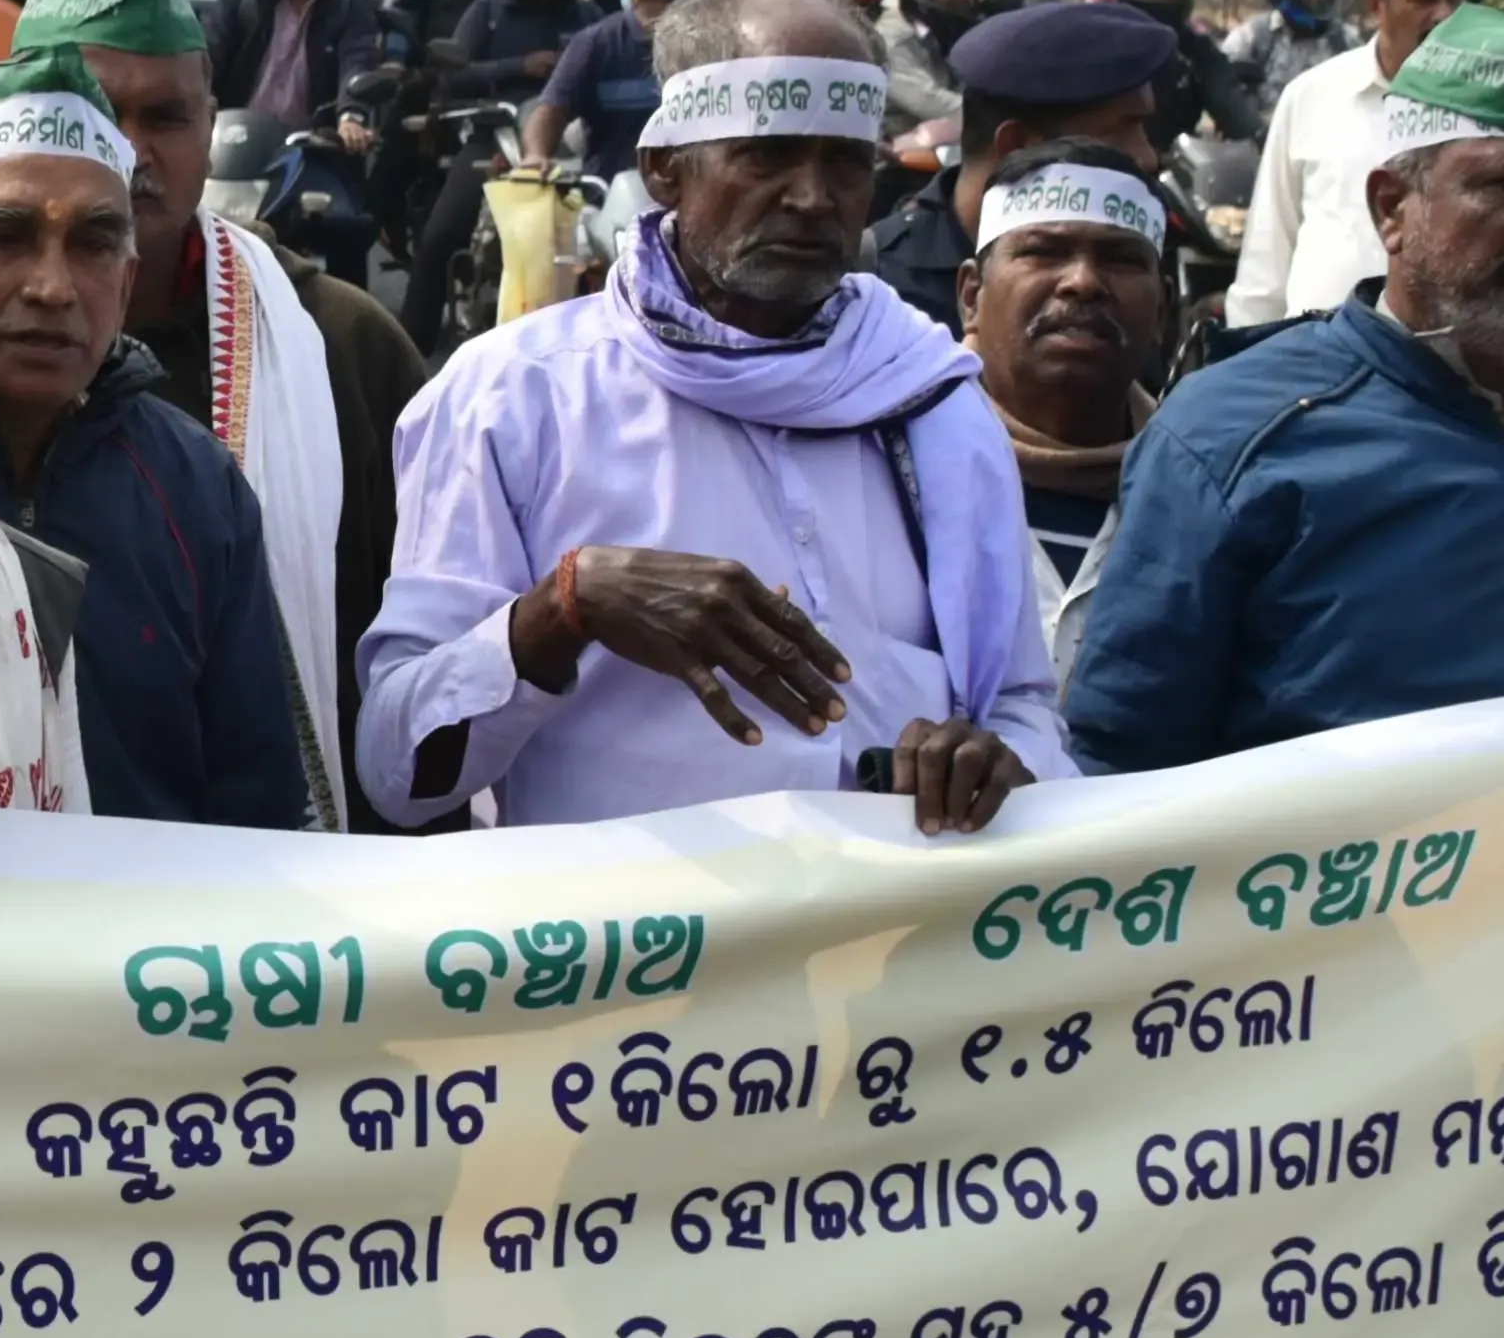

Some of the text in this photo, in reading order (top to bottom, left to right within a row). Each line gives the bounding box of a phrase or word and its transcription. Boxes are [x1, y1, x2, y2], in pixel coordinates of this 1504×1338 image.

[744, 78, 812, 126] କୃଷକ
[972, 865, 1196, 961] ଦେଶ
[24, 1065, 298, 1204] କହୁଛନ୍ତି
[338, 1065, 498, 1153] କାଟ
[855, 1036, 915, 1126] ରୁ
[1131, 976, 1315, 1060] କିଲୋ
[129, 1241, 177, 1317] ୨
[227, 1209, 443, 1303] କିଲୋ
[482, 1193, 639, 1273] କାଟ
[1136, 1110, 1400, 1204] ଯୋଗାଣ
[1260, 1235, 1444, 1328] କିଲୋ
